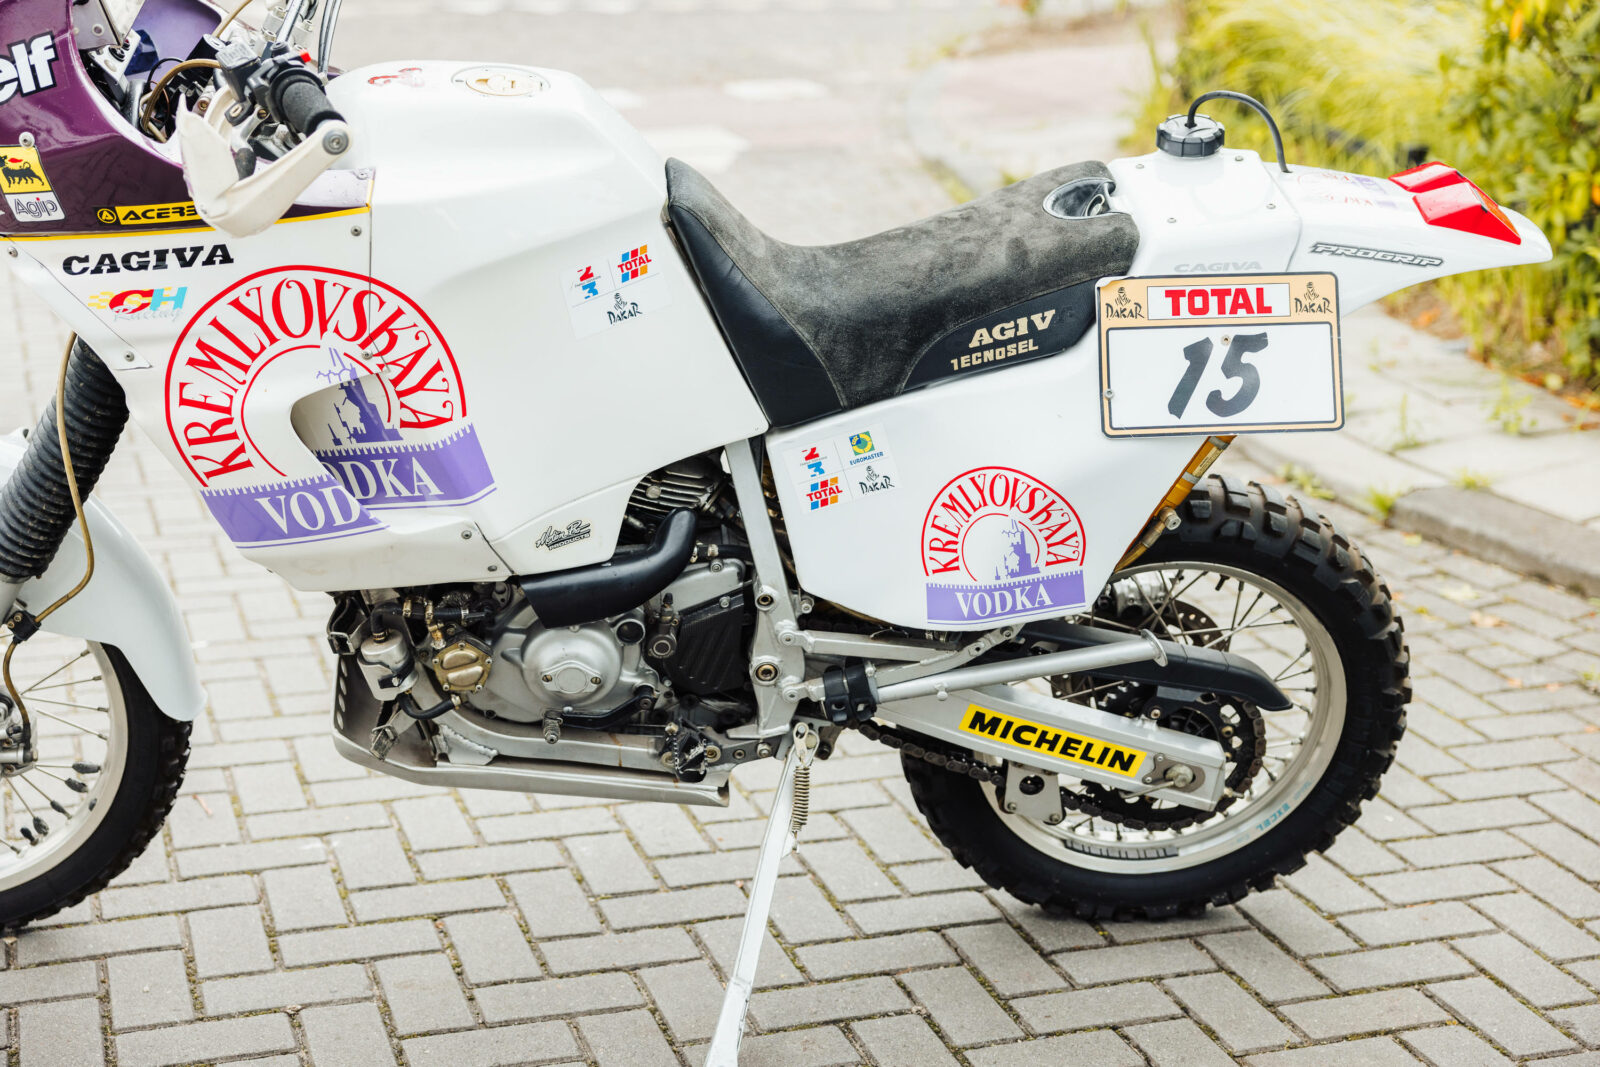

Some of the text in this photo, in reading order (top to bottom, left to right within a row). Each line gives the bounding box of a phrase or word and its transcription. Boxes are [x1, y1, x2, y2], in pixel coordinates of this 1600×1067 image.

[14, 196, 58, 218] Agip
[122, 206, 198, 221] ACERB
[62, 243, 234, 276] CAGIVA
[617, 254, 652, 273] TOTAL
[1310, 242, 1444, 267] PROGRIP
[1174, 261, 1263, 273] CAGIVA
[607, 302, 643, 325] DAKAR
[1105, 287, 1334, 320] DAKAR TOTAL DAKAR
[178, 277, 454, 481] KREMLYOVSKAYA
[1167, 332, 1269, 420] 15
[849, 451, 884, 466] EUROMASTER
[806, 485, 843, 502] TOTAL
[859, 475, 895, 494] DAKAR
[928, 473, 1081, 575] KREMLYOVSKAYA
[954, 582, 1054, 619] VODKA
[968, 710, 1137, 773] MICHELIN
